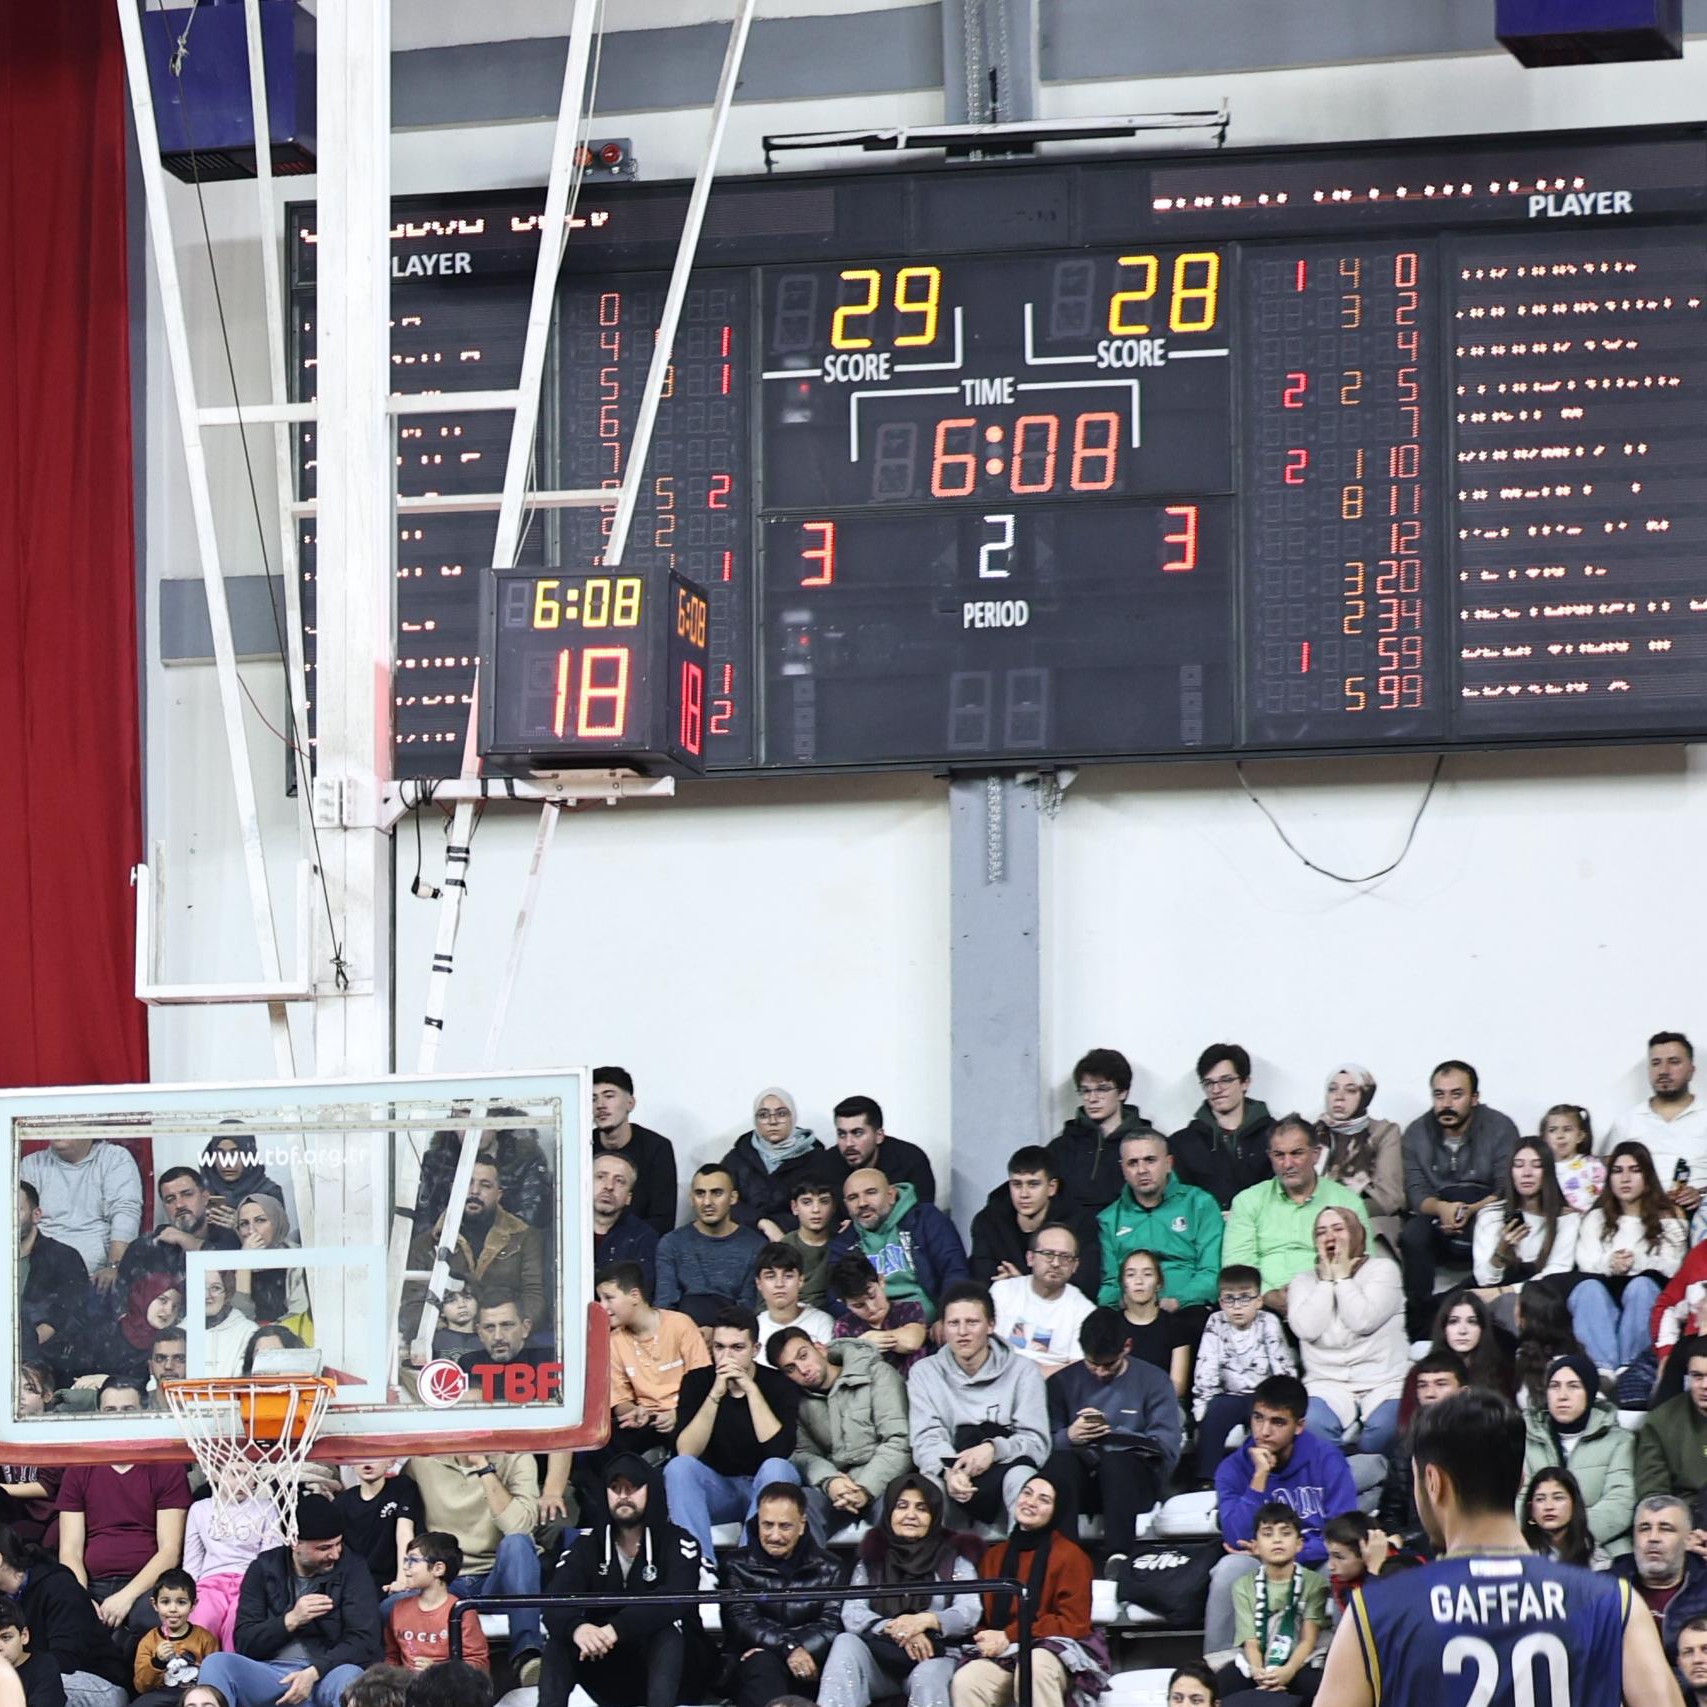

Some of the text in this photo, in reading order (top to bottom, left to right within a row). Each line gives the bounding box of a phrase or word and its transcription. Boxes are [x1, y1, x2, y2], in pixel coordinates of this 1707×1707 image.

[1528, 190, 1632, 219] PLAYER
[390, 252, 472, 278] LAYER
[1297, 253, 1419, 292] 1 4 0
[831, 267, 940, 349] 29
[1108, 253, 1219, 335] 28
[1341, 291, 1419, 328] 3 2
[600, 332, 620, 361] 4
[1097, 339, 1166, 367] SCORE
[1397, 331, 1420, 362] 4
[601, 367, 619, 400] 5
[824, 353, 891, 382] SCORE
[962, 377, 1015, 405] TIME
[1283, 368, 1420, 408] 2 2 5
[600, 405, 619, 437] 6
[1400, 406, 1420, 438] 7
[603, 442, 620, 473] 7
[931, 412, 1119, 497] 6:08
[1284, 449, 1309, 484] 2
[1389, 444, 1420, 478] 10
[655, 476, 675, 510] 5
[709, 475, 731, 508] 2
[1342, 484, 1421, 519] 8 11
[655, 514, 675, 548] 2
[979, 514, 1015, 577] 2
[1163, 506, 1197, 570] 3
[1390, 521, 1421, 554] 12
[801, 521, 834, 586] 3
[1343, 559, 1421, 596] 3 20
[533, 578, 642, 629] 6:08
[677, 587, 707, 649] 6:08
[964, 600, 1028, 628] PERIOD
[1343, 599, 1422, 634] 2 34
[1378, 636, 1422, 671] 59
[554, 647, 629, 738] 18
[680, 660, 703, 755] 18
[1345, 675, 1423, 711] 5 99
[710, 700, 732, 734] 2
[196, 1142, 371, 1170] www.tbf.org.tr
[471, 1362, 563, 1404] TBF
[1429, 1580, 1567, 1625] GAFFAR
